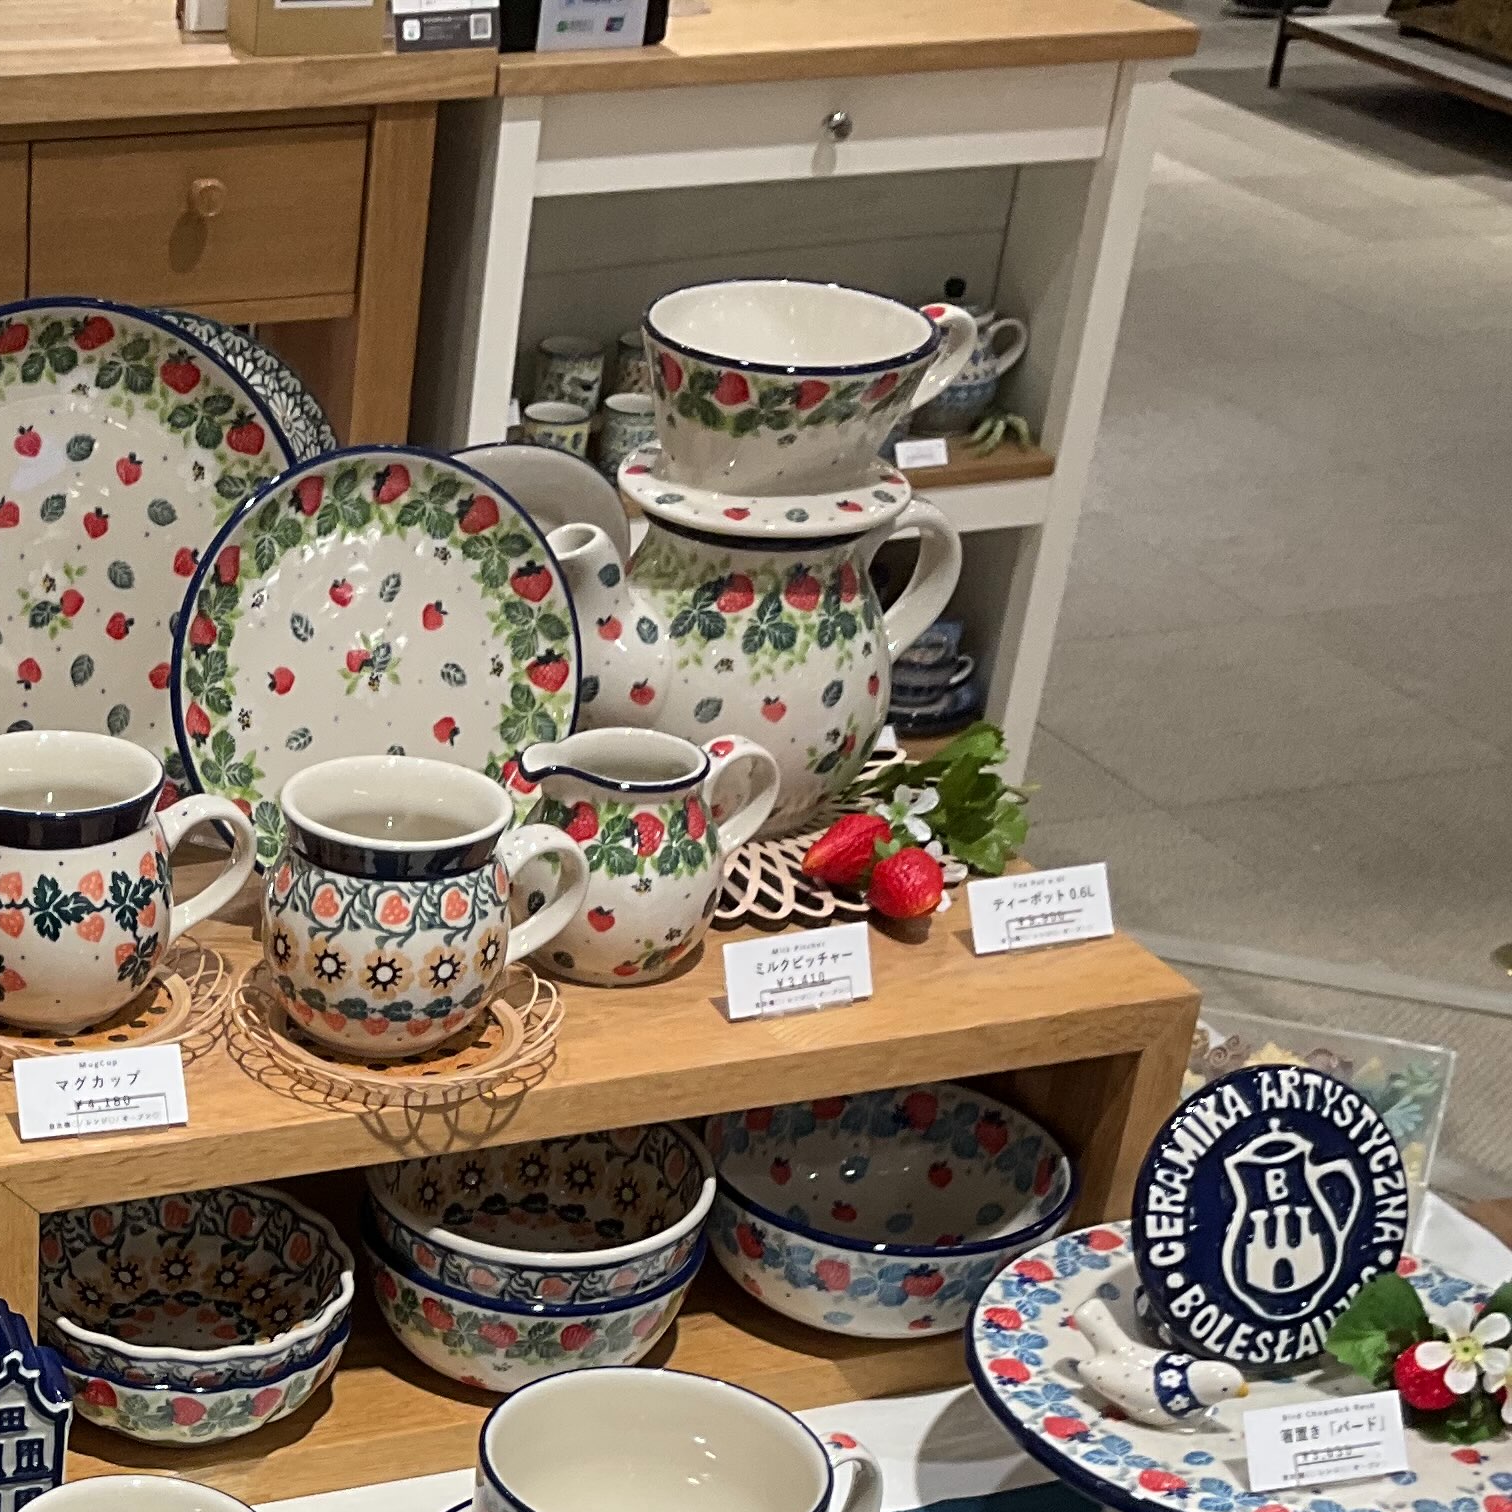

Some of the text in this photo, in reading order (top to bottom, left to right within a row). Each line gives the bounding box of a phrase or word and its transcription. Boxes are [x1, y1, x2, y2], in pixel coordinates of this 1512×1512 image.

[755, 952, 853, 975] ミルクピッチャー
[56, 1070, 141, 1091] マグカップ
[1145, 1066, 1408, 1267] CERAMIKA ARTYSTYCZNA
